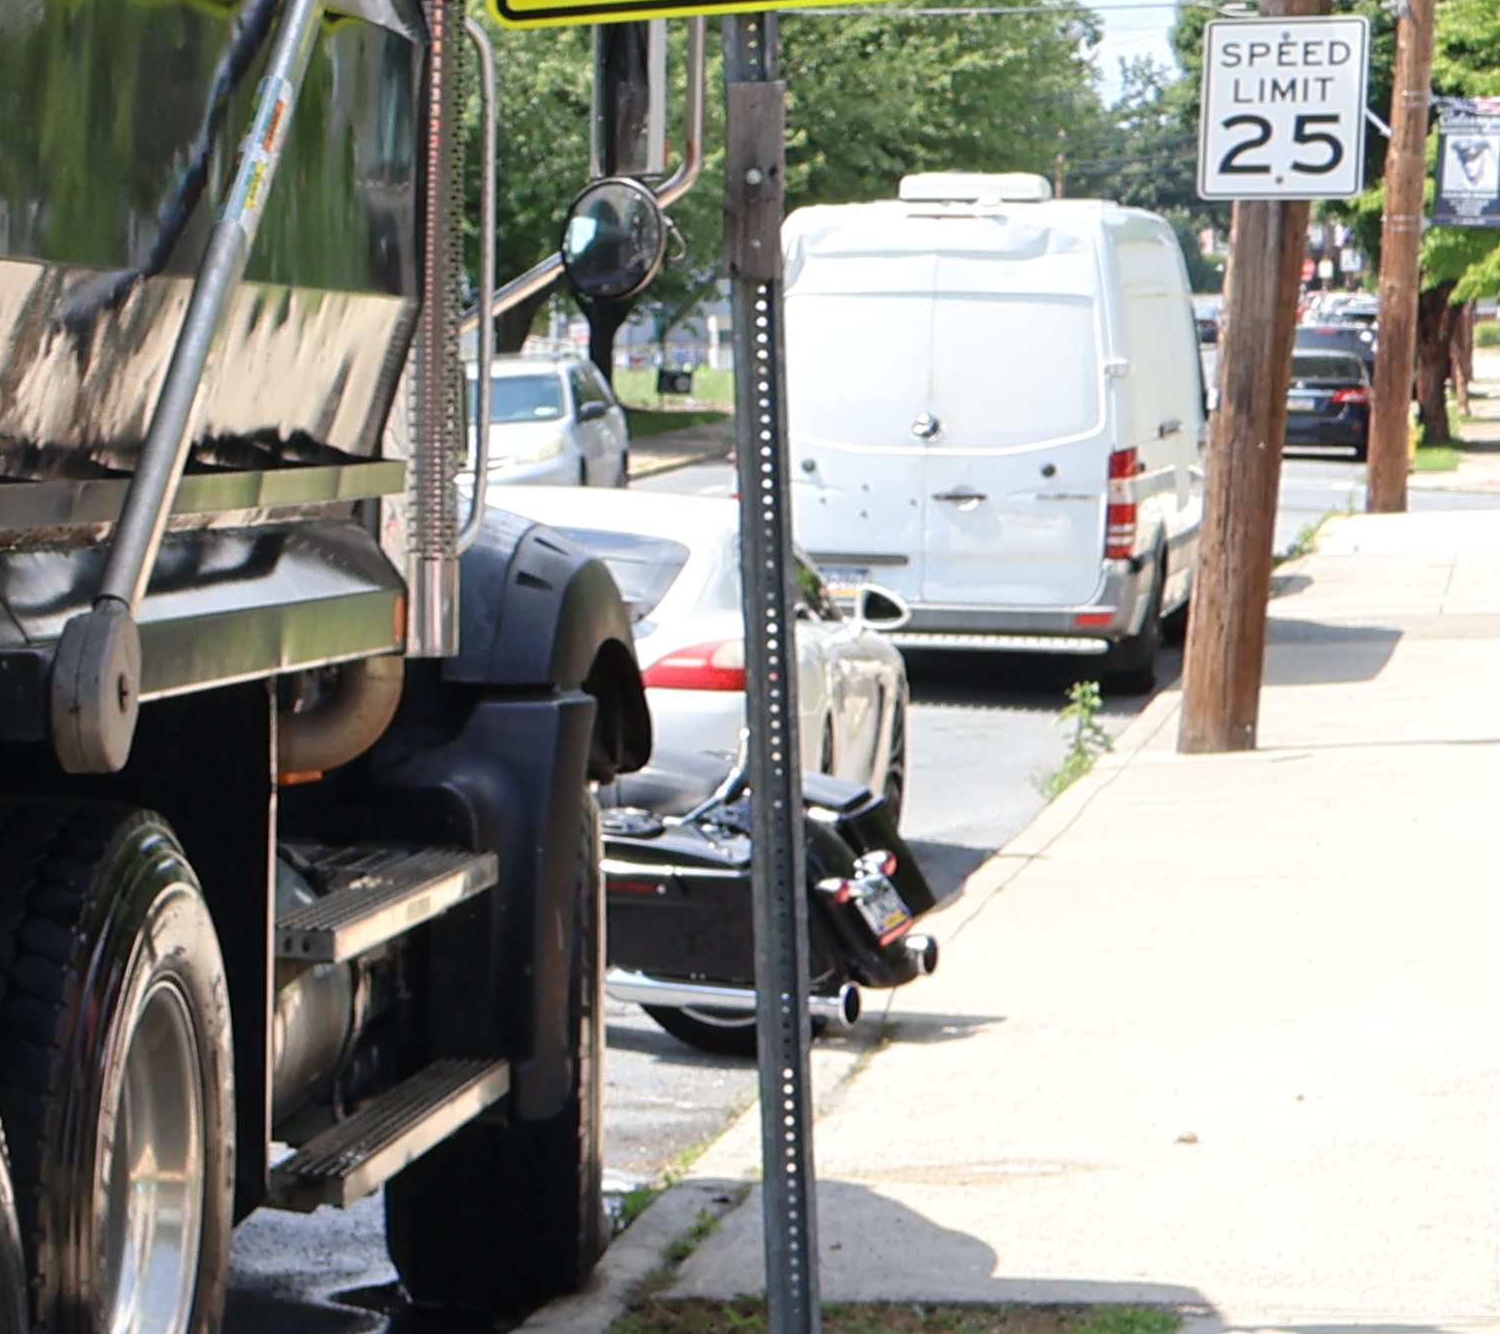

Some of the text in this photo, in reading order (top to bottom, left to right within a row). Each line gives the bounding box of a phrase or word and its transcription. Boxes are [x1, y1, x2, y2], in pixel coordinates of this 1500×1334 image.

[1221, 41, 1351, 68] SPEED
[1233, 77, 1335, 103] LIMIT
[1218, 113, 1344, 175] 25
